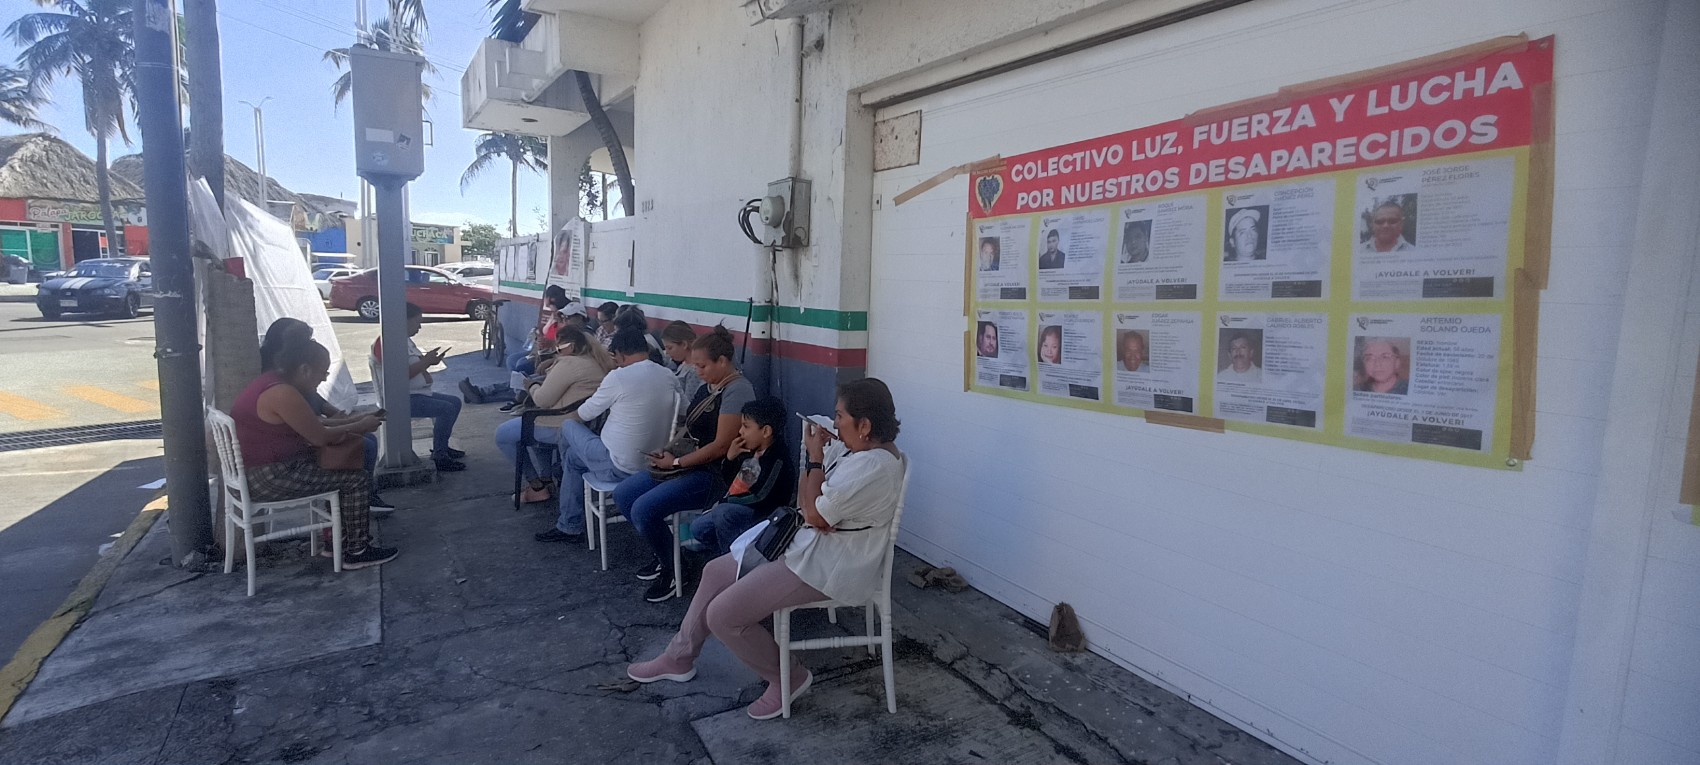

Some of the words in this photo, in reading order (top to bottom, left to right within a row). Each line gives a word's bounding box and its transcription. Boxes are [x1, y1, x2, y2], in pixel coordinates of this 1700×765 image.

[1011, 144, 1123, 182] COLECTIVO
[1131, 131, 1183, 162] LUZ,
[1193, 103, 1317, 149] FUERZA
[1329, 94, 1356, 122] Y
[1366, 61, 1524, 117] LUCHA
[1016, 188, 1054, 210] POR
[1061, 166, 1180, 205] NUESTROS
[1189, 114, 1500, 186] DESAPARECIDOS
[30, 205, 68, 220] Palapa
[65, 210, 120, 222] JAROCA
[411, 229, 448, 239] UCHACA
[1432, 268, 1476, 277] VOLVER!
[1420, 317, 1463, 325] ARTEMIO
[1420, 325, 1459, 333] SOLANO
[1460, 326, 1492, 334] OJEDA
[1367, 409, 1409, 421] ¡AYÚDALE
[1412, 414, 1419, 422] A
[1421, 416, 1465, 426] VOLVER!
